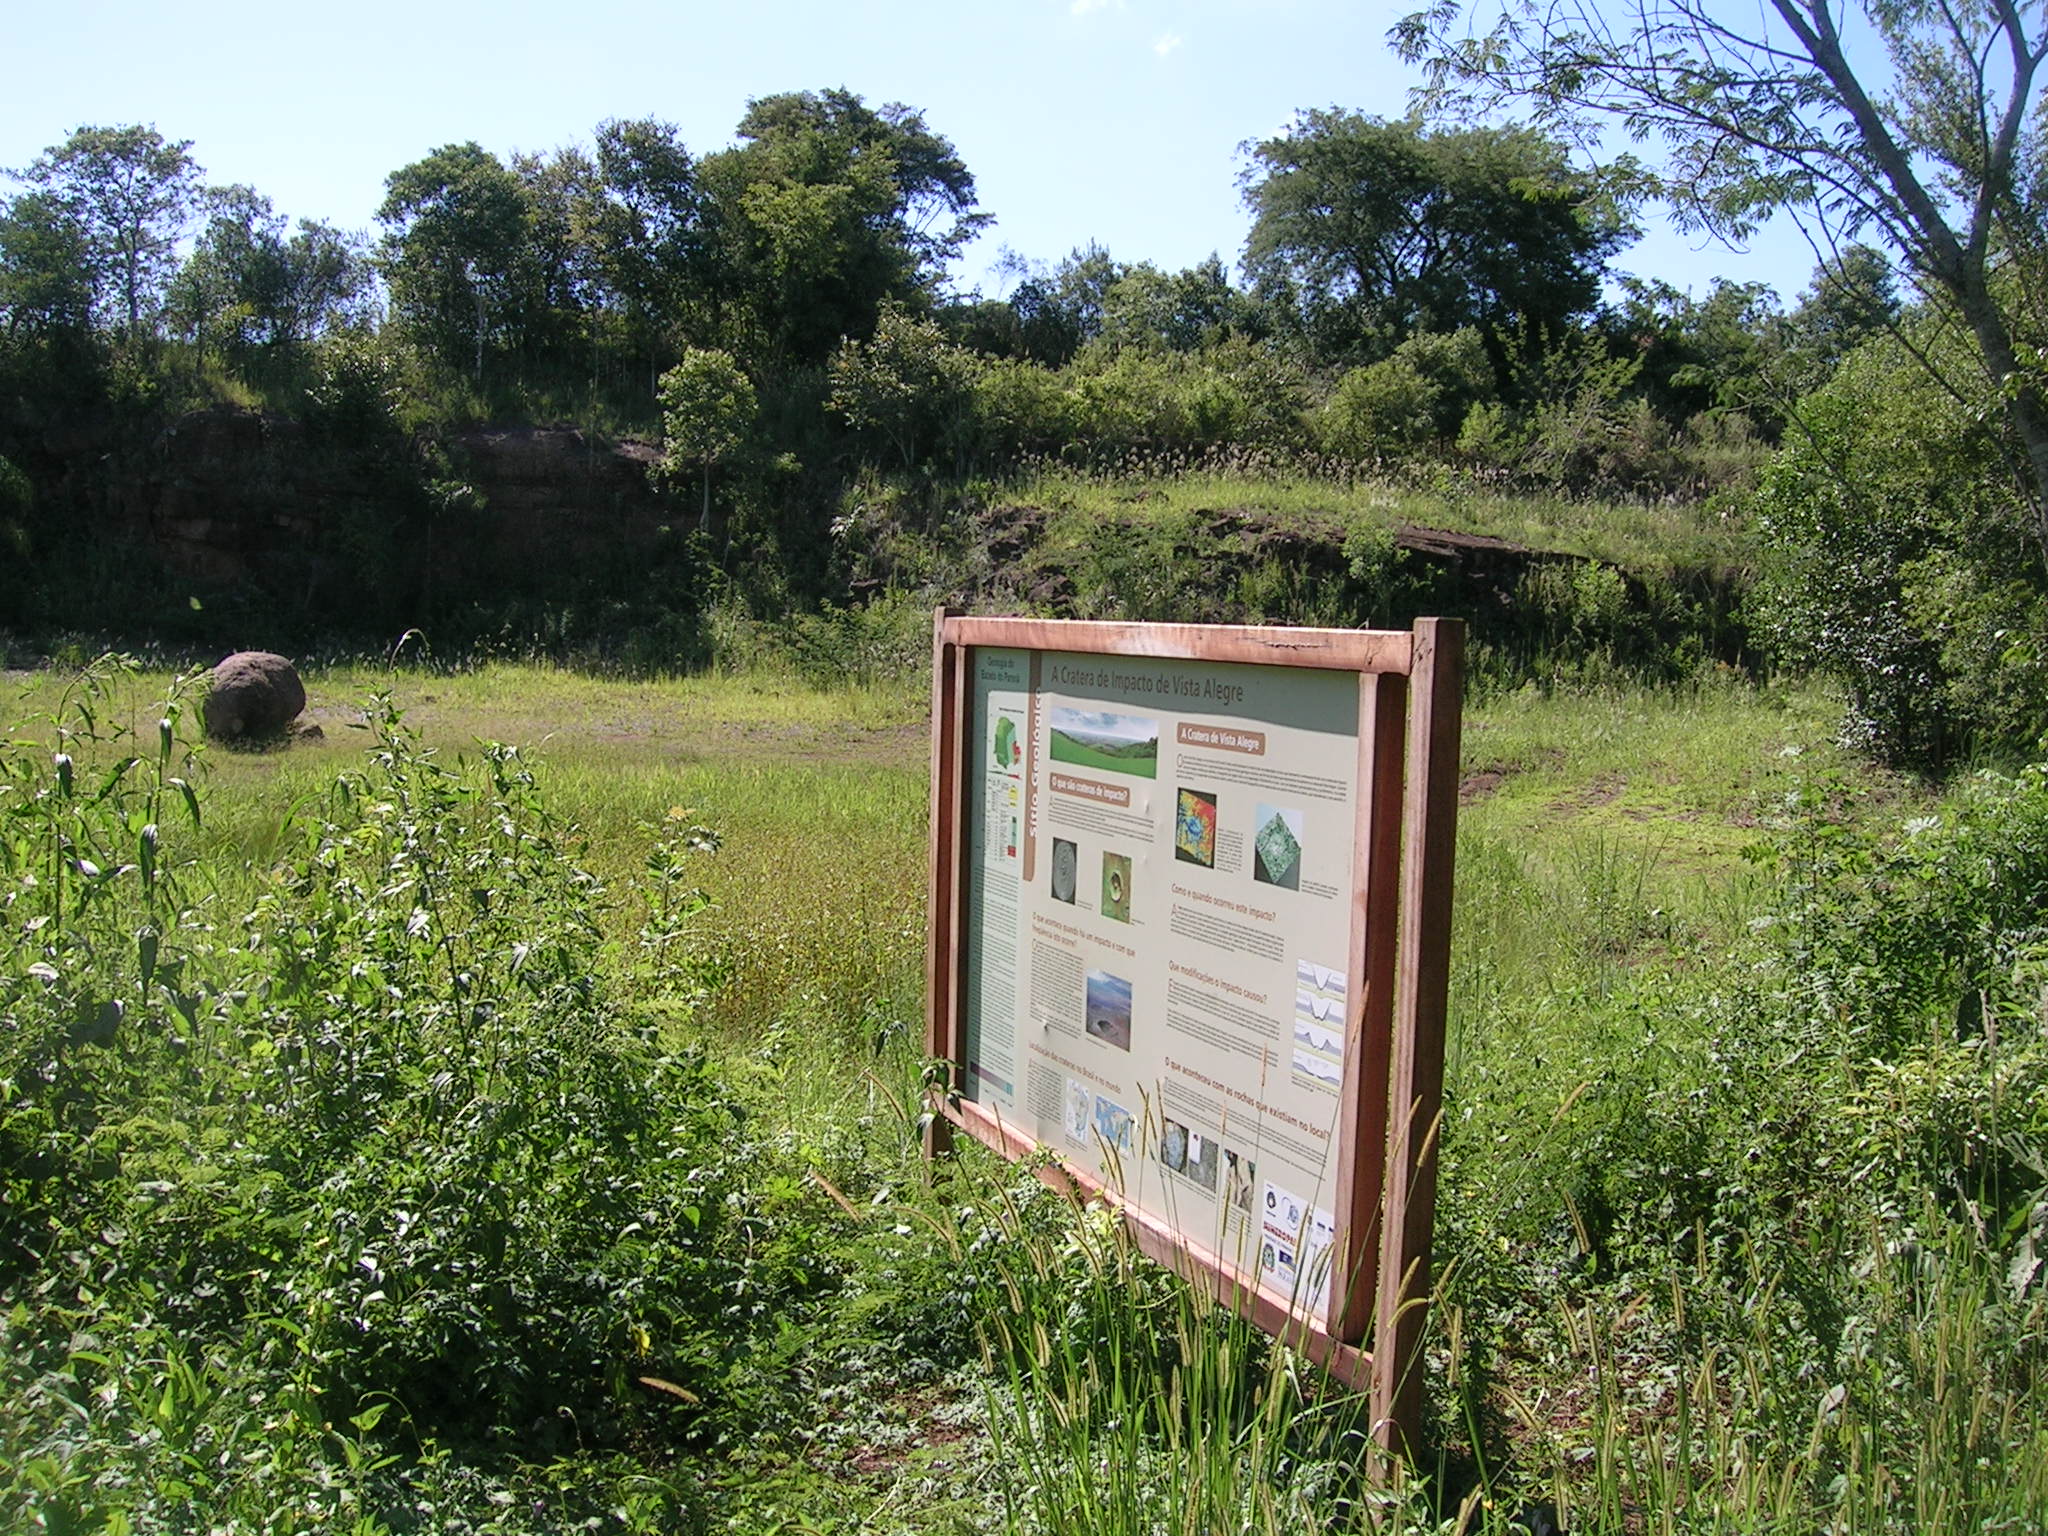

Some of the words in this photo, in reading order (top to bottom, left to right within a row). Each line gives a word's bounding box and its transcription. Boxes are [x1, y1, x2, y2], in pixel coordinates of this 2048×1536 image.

[1051, 666, 1059, 682] A
[1061, 666, 1095, 687] Cratera
[1097, 669, 1110, 688] de
[1112, 670, 1153, 693] Impacto
[1156, 674, 1169, 694] de
[1173, 675, 1200, 697] Vista
[1203, 679, 1244, 705] Alegre
[1187, 728, 1209, 742] Cratera
[1210, 731, 1219, 744] de
[1220, 732, 1237, 746] Vista
[1237, 735, 1260, 751] Alegre
[1171, 883, 1187, 896] Como
[1249, 905, 1276, 921] impacto?
[1171, 1061, 1181, 1072] que
[1212, 1080, 1225, 1093] com
